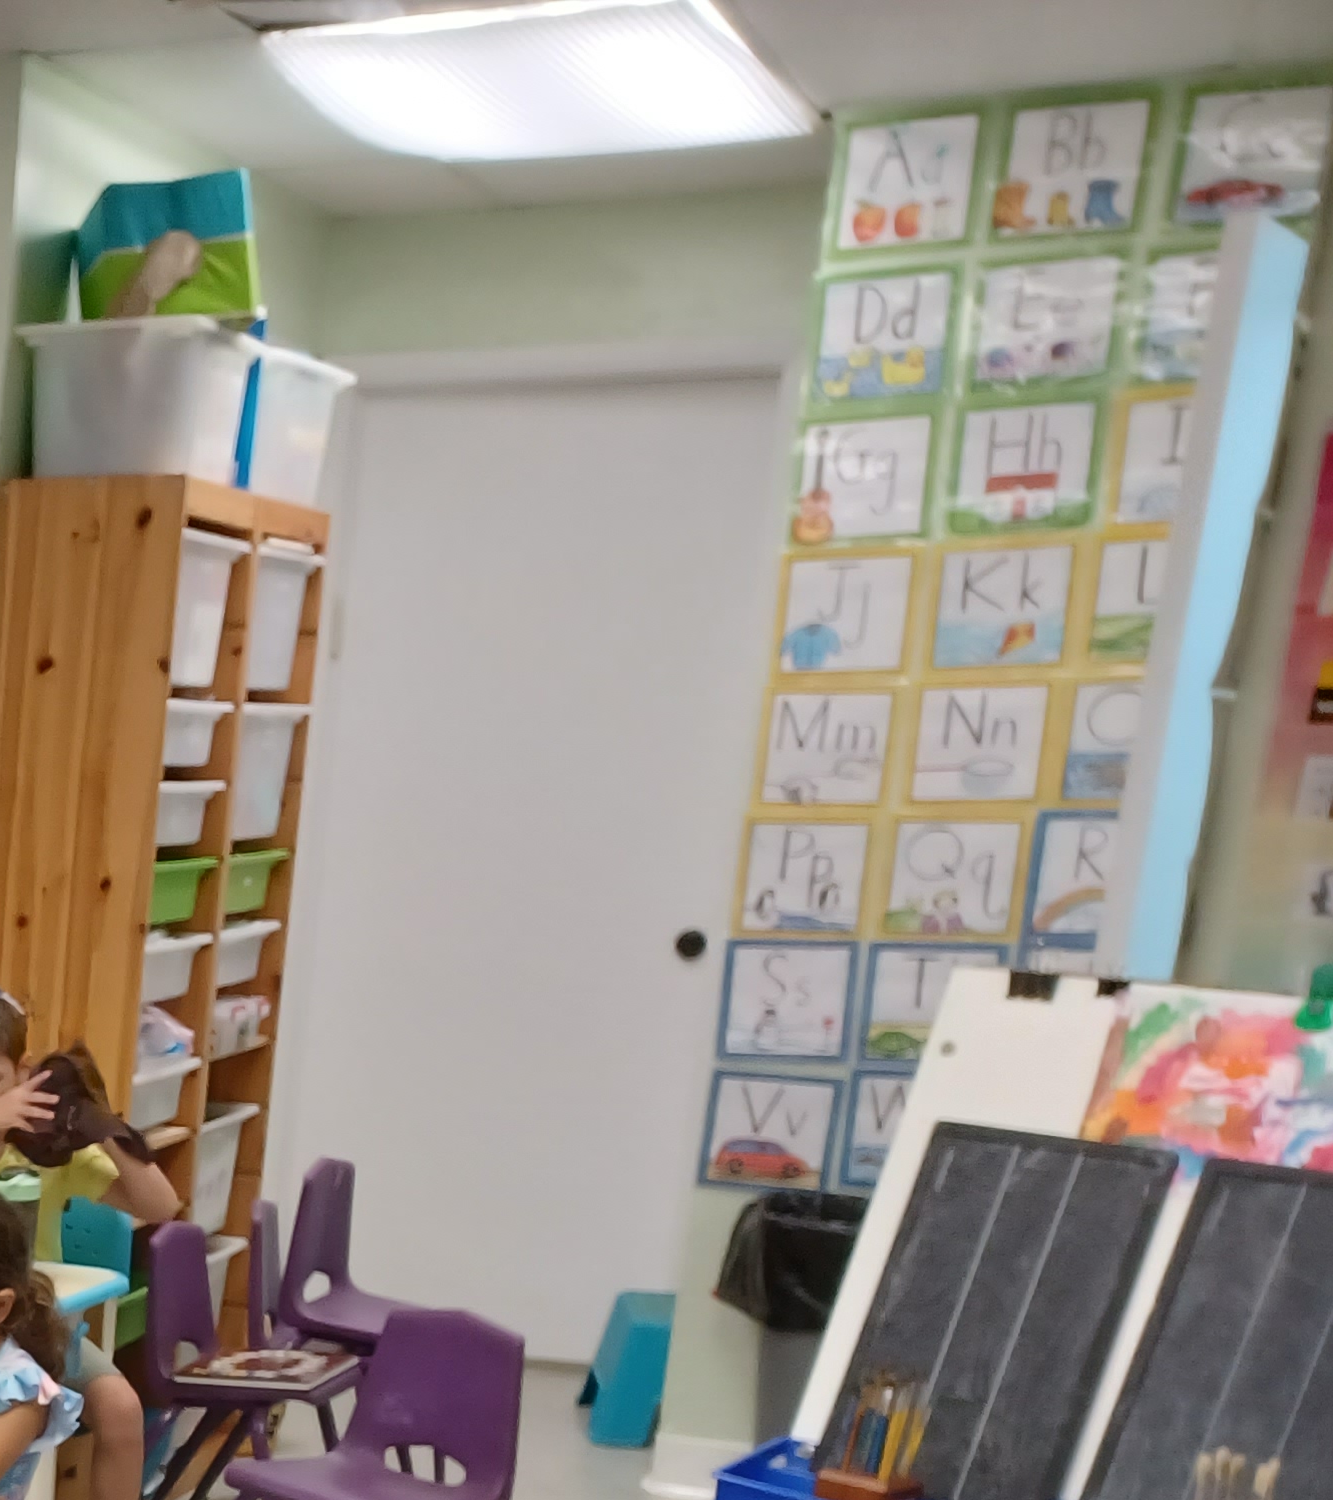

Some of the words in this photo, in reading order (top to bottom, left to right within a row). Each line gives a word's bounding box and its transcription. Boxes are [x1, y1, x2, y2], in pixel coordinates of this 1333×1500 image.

[1044, 110, 1108, 176] Bb
[854, 279, 921, 345] Dd
[987, 412, 1062, 476] Hh
[817, 561, 871, 649] Jj
[961, 552, 1044, 614] Kk
[776, 699, 877, 752] Mm
[943, 691, 1018, 750] Nn
[780, 828, 834, 906] Pp
[906, 826, 1007, 919] Qq
[1074, 826, 1109, 881] R
[741, 1083, 809, 1137] Vv
